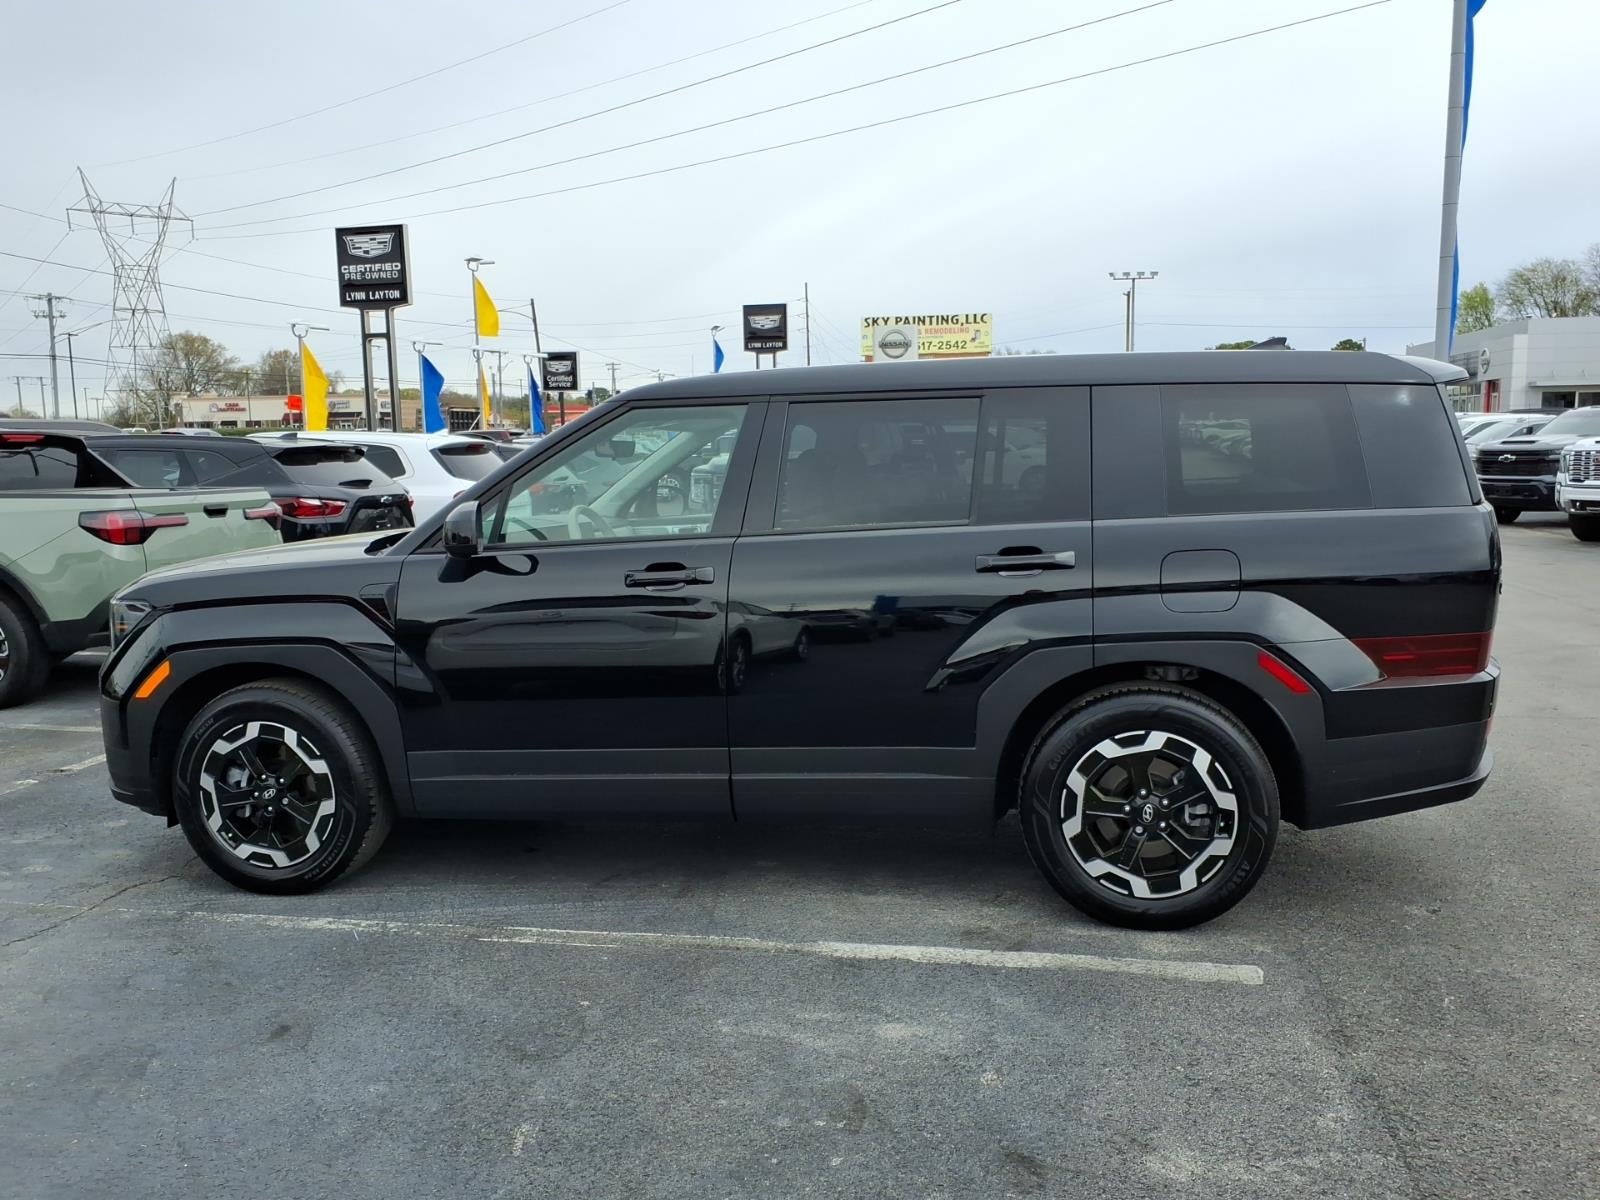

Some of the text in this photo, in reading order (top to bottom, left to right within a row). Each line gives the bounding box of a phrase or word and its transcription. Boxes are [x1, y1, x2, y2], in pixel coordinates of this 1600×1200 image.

[341, 263, 401, 273] CERTIFIED
[344, 271, 399, 280] PRE-OWNED
[346, 290, 400, 301] LYNN LAYTON
[864, 316, 890, 328] SKY
